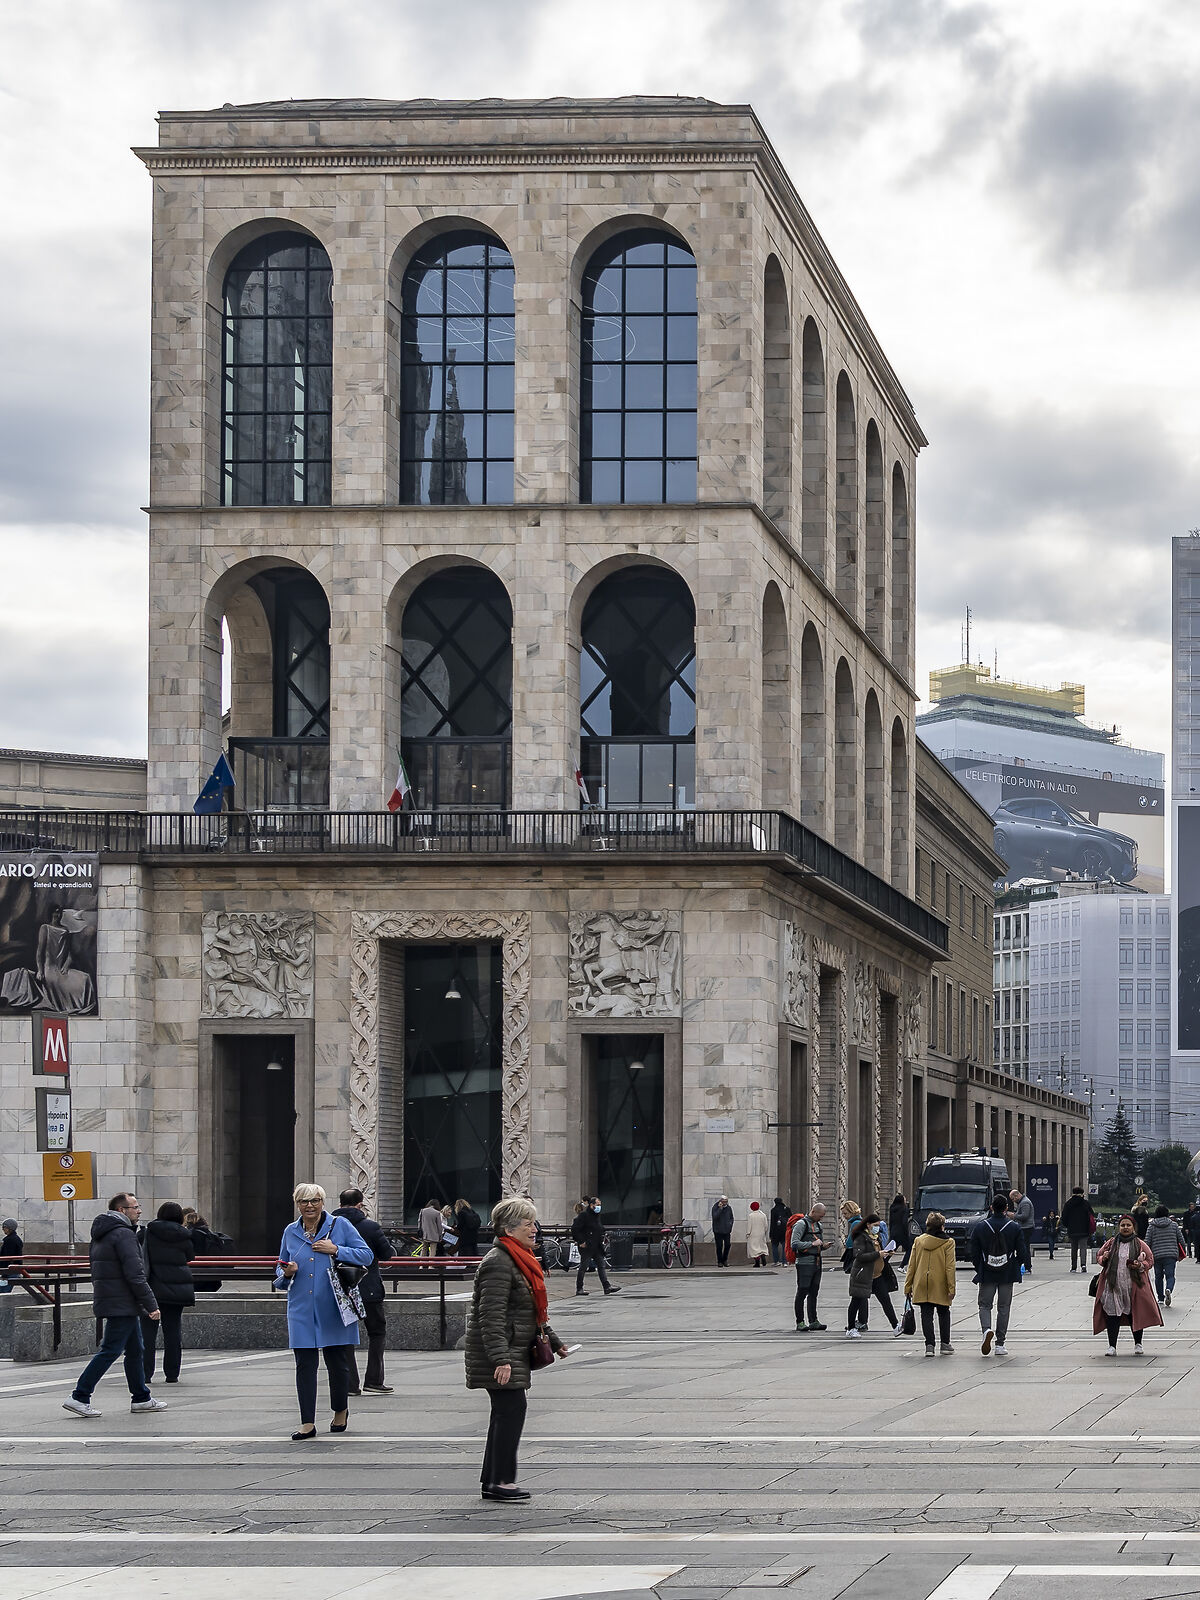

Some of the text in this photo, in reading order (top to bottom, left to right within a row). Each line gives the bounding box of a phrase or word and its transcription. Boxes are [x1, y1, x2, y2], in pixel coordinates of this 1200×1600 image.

[965, 769, 1078, 795] L'ELETTRICO PUNTA IN ALTO.
[40, 864, 92, 877] SIRONI
[44, 1027, 67, 1062] M
[59, 1124, 65, 1132] B
[58, 1136, 64, 1145] C
